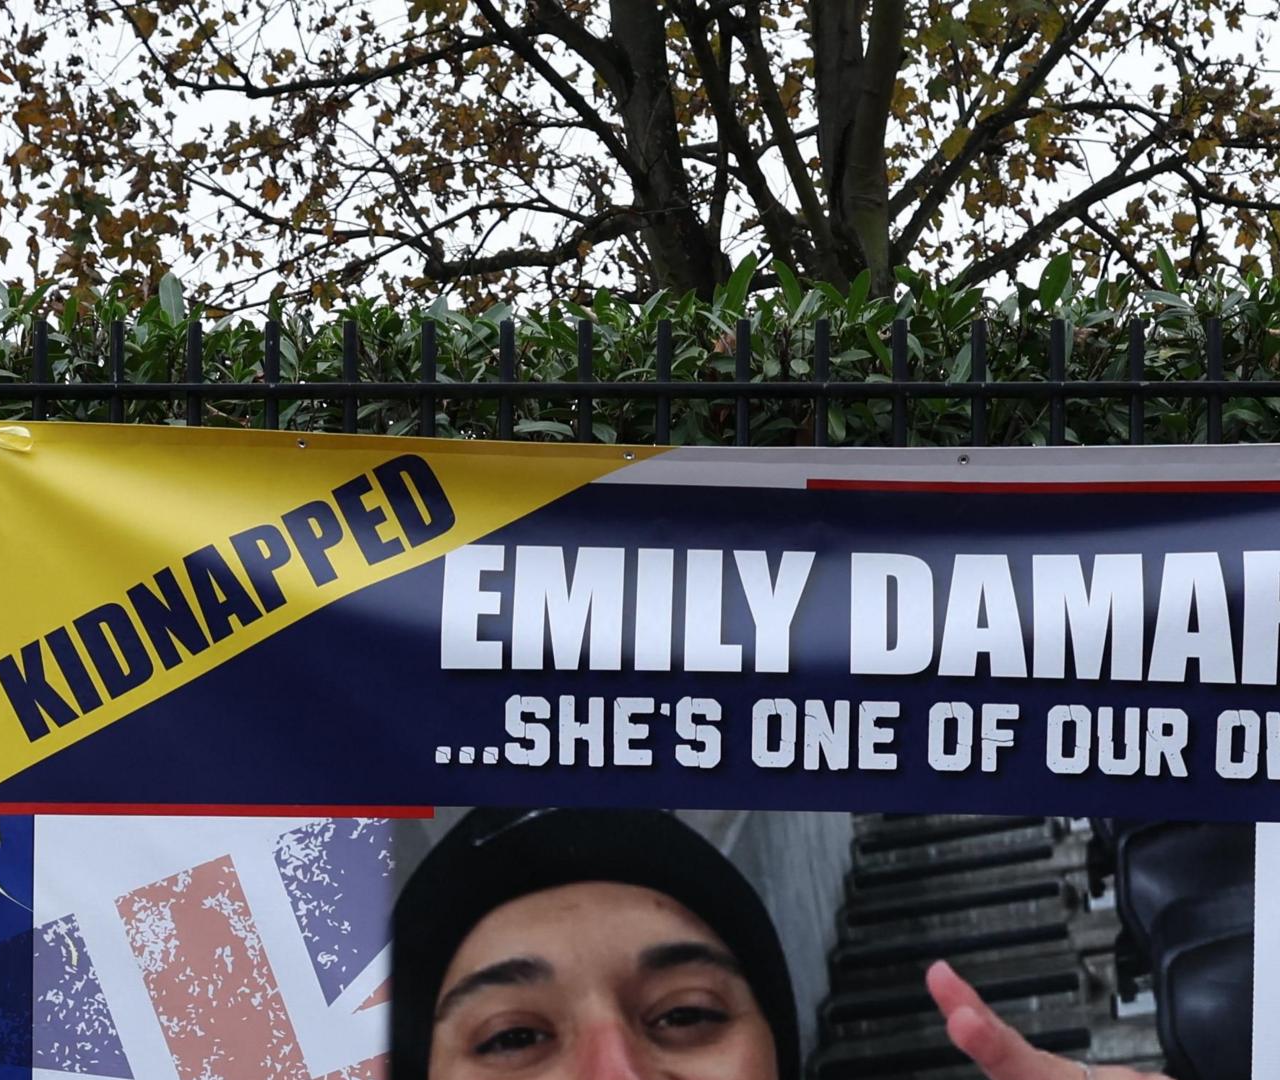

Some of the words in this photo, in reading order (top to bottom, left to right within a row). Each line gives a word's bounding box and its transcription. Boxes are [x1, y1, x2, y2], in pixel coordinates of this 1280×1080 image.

[439, 544, 817, 674] EMILY
[435, 694, 723, 769] ...SHE'S
[750, 698, 900, 771] ONE
[927, 701, 1020, 774] OF
[1046, 704, 1189, 778] OUR
